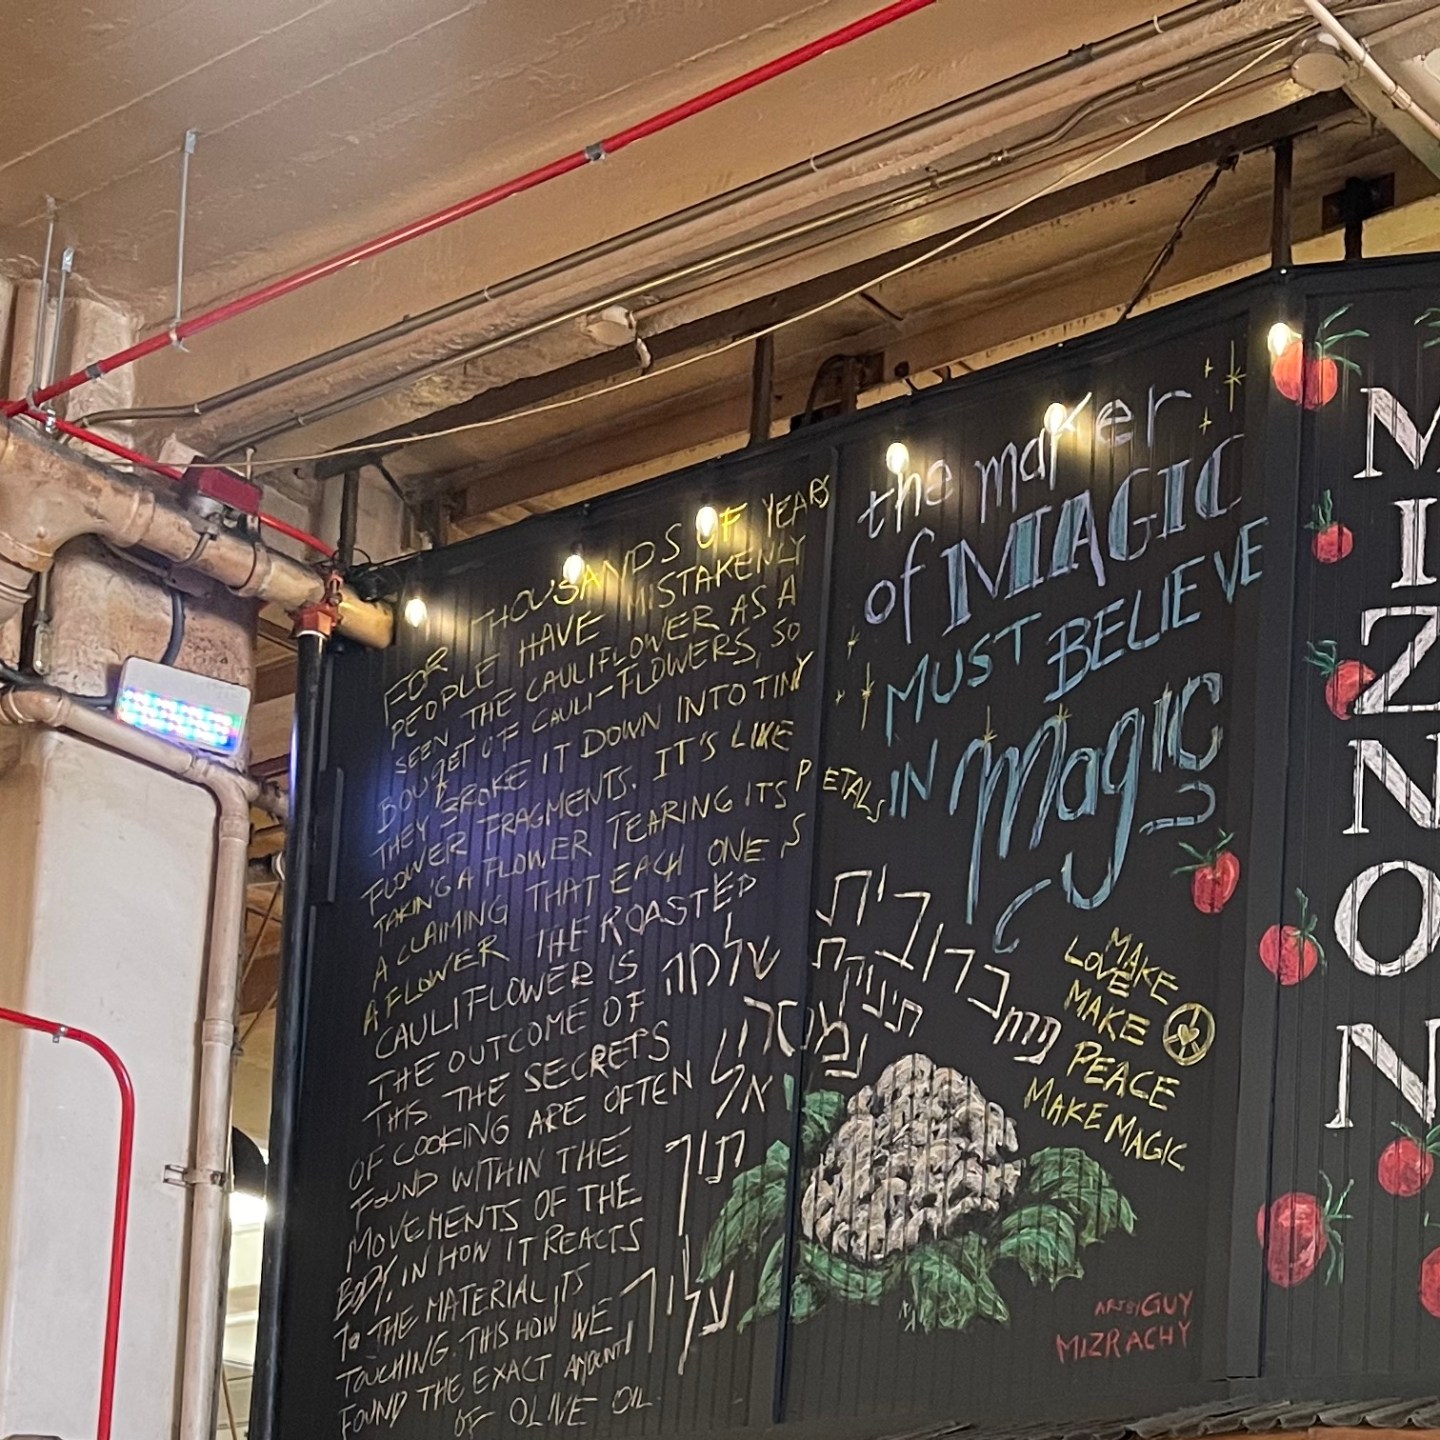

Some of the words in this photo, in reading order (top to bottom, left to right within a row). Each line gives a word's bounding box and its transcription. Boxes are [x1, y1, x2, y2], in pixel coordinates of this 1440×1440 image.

[857, 442, 953, 540] the
[975, 385, 1191, 524] maker
[864, 528, 935, 644] of
[940, 434, 1245, 636] MAGIC
[390, 653, 497, 750] PEOPLE
[518, 613, 606, 670] HAVE
[625, 535, 808, 621] MISTAKENLY
[395, 732, 450, 775] SEEN
[465, 690, 518, 731] THE
[525, 603, 720, 703] CAULIFLOWER
[730, 586, 770, 626] AS
[776, 575, 797, 609] A
[885, 613, 1043, 747] MUST
[1044, 517, 1269, 703] BELIEVE
[383, 648, 450, 726] FOR
[370, 815, 430, 870] THEY
[440, 759, 532, 828] BROKE
[542, 742, 572, 774] IT
[581, 711, 662, 760] DOWN
[676, 683, 746, 721] INTO
[755, 652, 815, 698] TINY
[889, 739, 939, 819] IN
[361, 831, 468, 916] FLOWER
[477, 767, 638, 842] FRAGMENTS.
[653, 734, 717, 782] IT'S
[730, 720, 795, 753] LIKE
[457, 867, 473, 890] A
[482, 838, 593, 890] FLOWER
[606, 801, 734, 846] TEARING
[743, 782, 788, 808] ITS
[374, 961, 593, 1059] CAULIFLOWER
[608, 949, 640, 982] IS
[1064, 935, 1132, 998] LOVE
[1064, 979, 1150, 1046] MAKE
[1105, 927, 1179, 1005] MAKE
[368, 1054, 440, 1094] THE
[447, 1009, 587, 1074] OUTCOME
[603, 990, 649, 1028] OF
[441, 1078, 507, 1112] THE
[524, 1021, 672, 1092] SECRETS
[1067, 1040, 1180, 1111] PEACE
[348, 1154, 383, 1191] OF
[392, 1116, 510, 1168] COOKING
[528, 1098, 587, 1139] ARE
[603, 1062, 695, 1114] OFTEN
[1023, 1077, 1103, 1133] MAKE
[1104, 1114, 1187, 1172] MAGIC
[346, 1199, 521, 1273] MOVEMENTS
[533, 1185, 568, 1221] OF
[577, 1173, 643, 1210] THE
[349, 1171, 439, 1227] FOUND
[451, 1150, 543, 1195] WITHIN
[556, 1126, 631, 1168] THE
[459, 1320, 510, 1361] THIS
[515, 1316, 557, 1341] HOW
[571, 1297, 614, 1342] WE
[1056, 1320, 1192, 1364] MIZRACHY
[1141, 1290, 1193, 1317] GUY
[417, 1374, 466, 1411] THE
[473, 1354, 552, 1395] EXACT
[454, 1406, 496, 1440] OF
[510, 1392, 598, 1427] OLIVE
[612, 1386, 653, 1414] OIL
